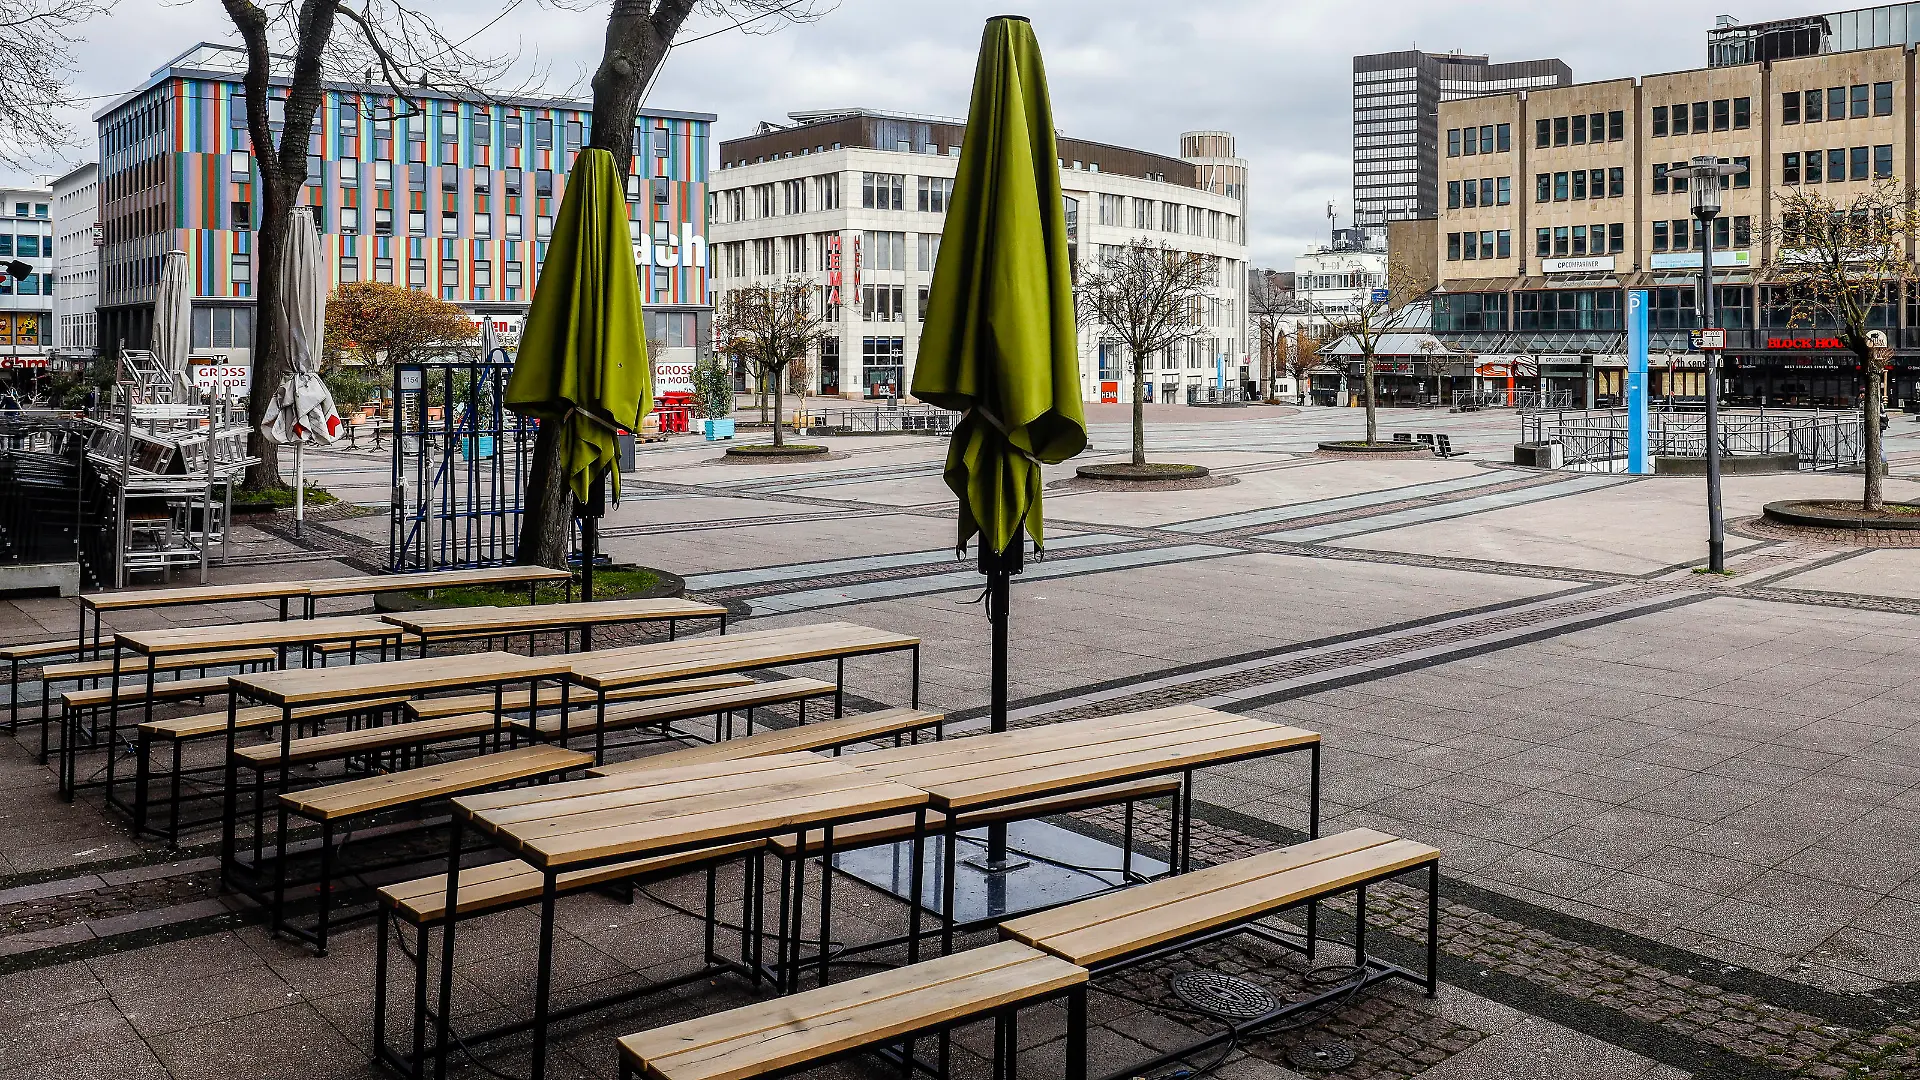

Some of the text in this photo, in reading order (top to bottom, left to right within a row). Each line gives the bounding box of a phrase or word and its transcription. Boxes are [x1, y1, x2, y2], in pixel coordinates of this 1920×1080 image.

[829, 235, 843, 305] HEMA
[1767, 338, 1847, 349] BLOCK HOU
[1, 356, 49, 369] öhm
[1665, 356, 1707, 368] sth sens
[198, 367, 246, 377] GROSS
[657, 365, 694, 375] GROSS
[199, 379, 210, 387] in
[657, 376, 694, 385] in MODE
